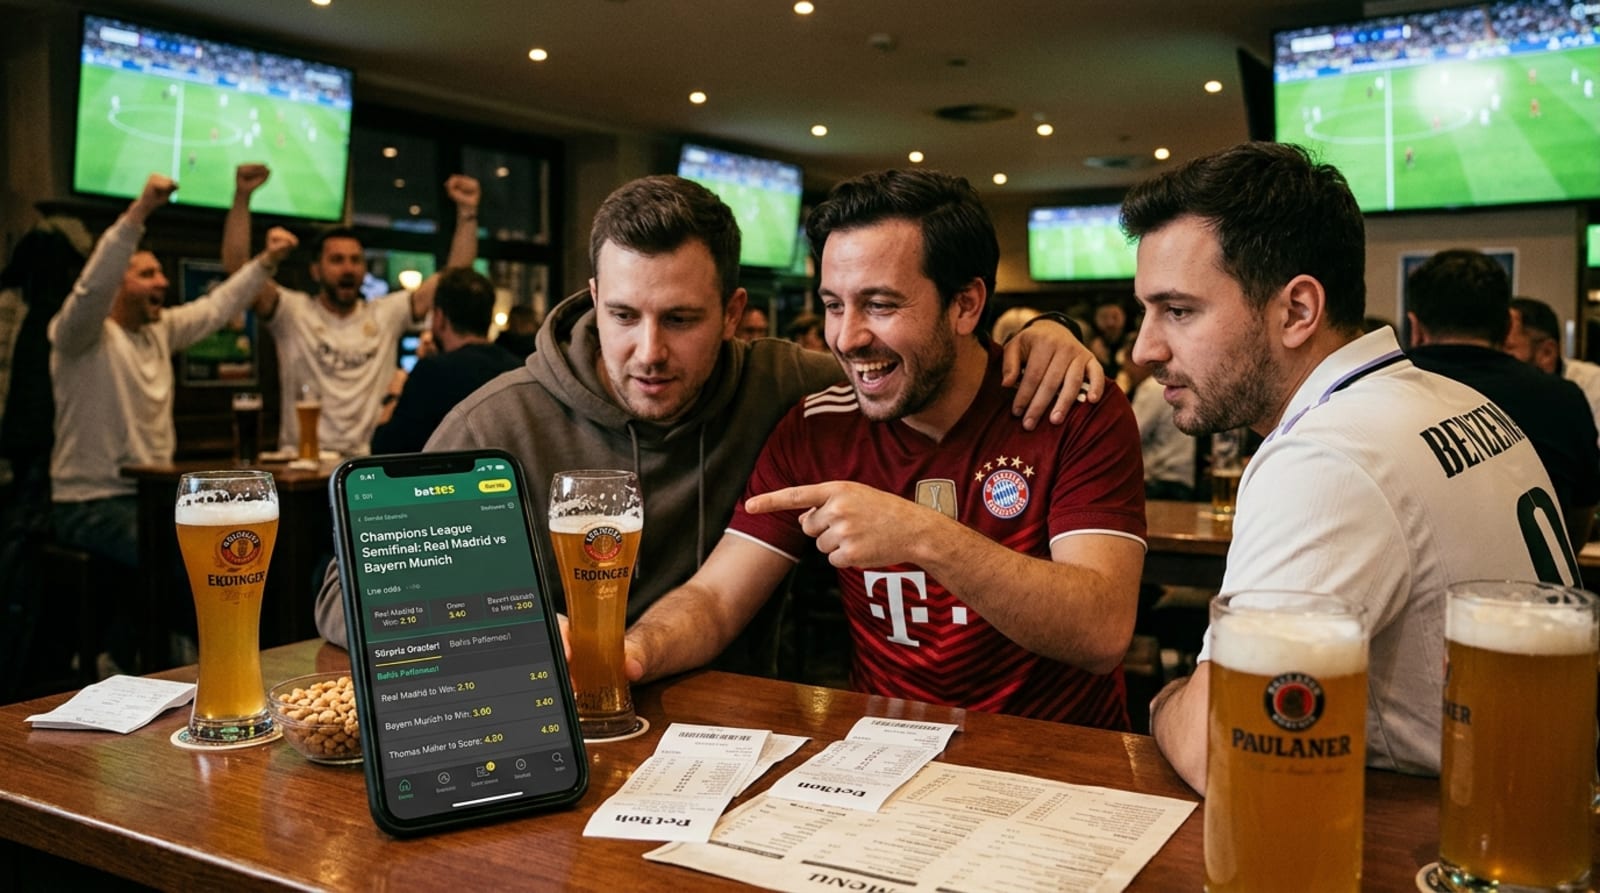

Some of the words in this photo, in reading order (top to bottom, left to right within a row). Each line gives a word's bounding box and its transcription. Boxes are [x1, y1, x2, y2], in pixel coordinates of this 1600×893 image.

[360, 528, 428, 543] Champions
[430, 524, 473, 537] League
[362, 542, 421, 558] Semifinal:
[423, 540, 449, 552] Real
[451, 535, 492, 549] Madrid
[493, 535, 507, 544] vs
[364, 560, 407, 574] Bayern
[409, 554, 453, 569] Munich
[457, 682, 475, 691] 2.10
[1232, 727, 1351, 758] PAULANER
